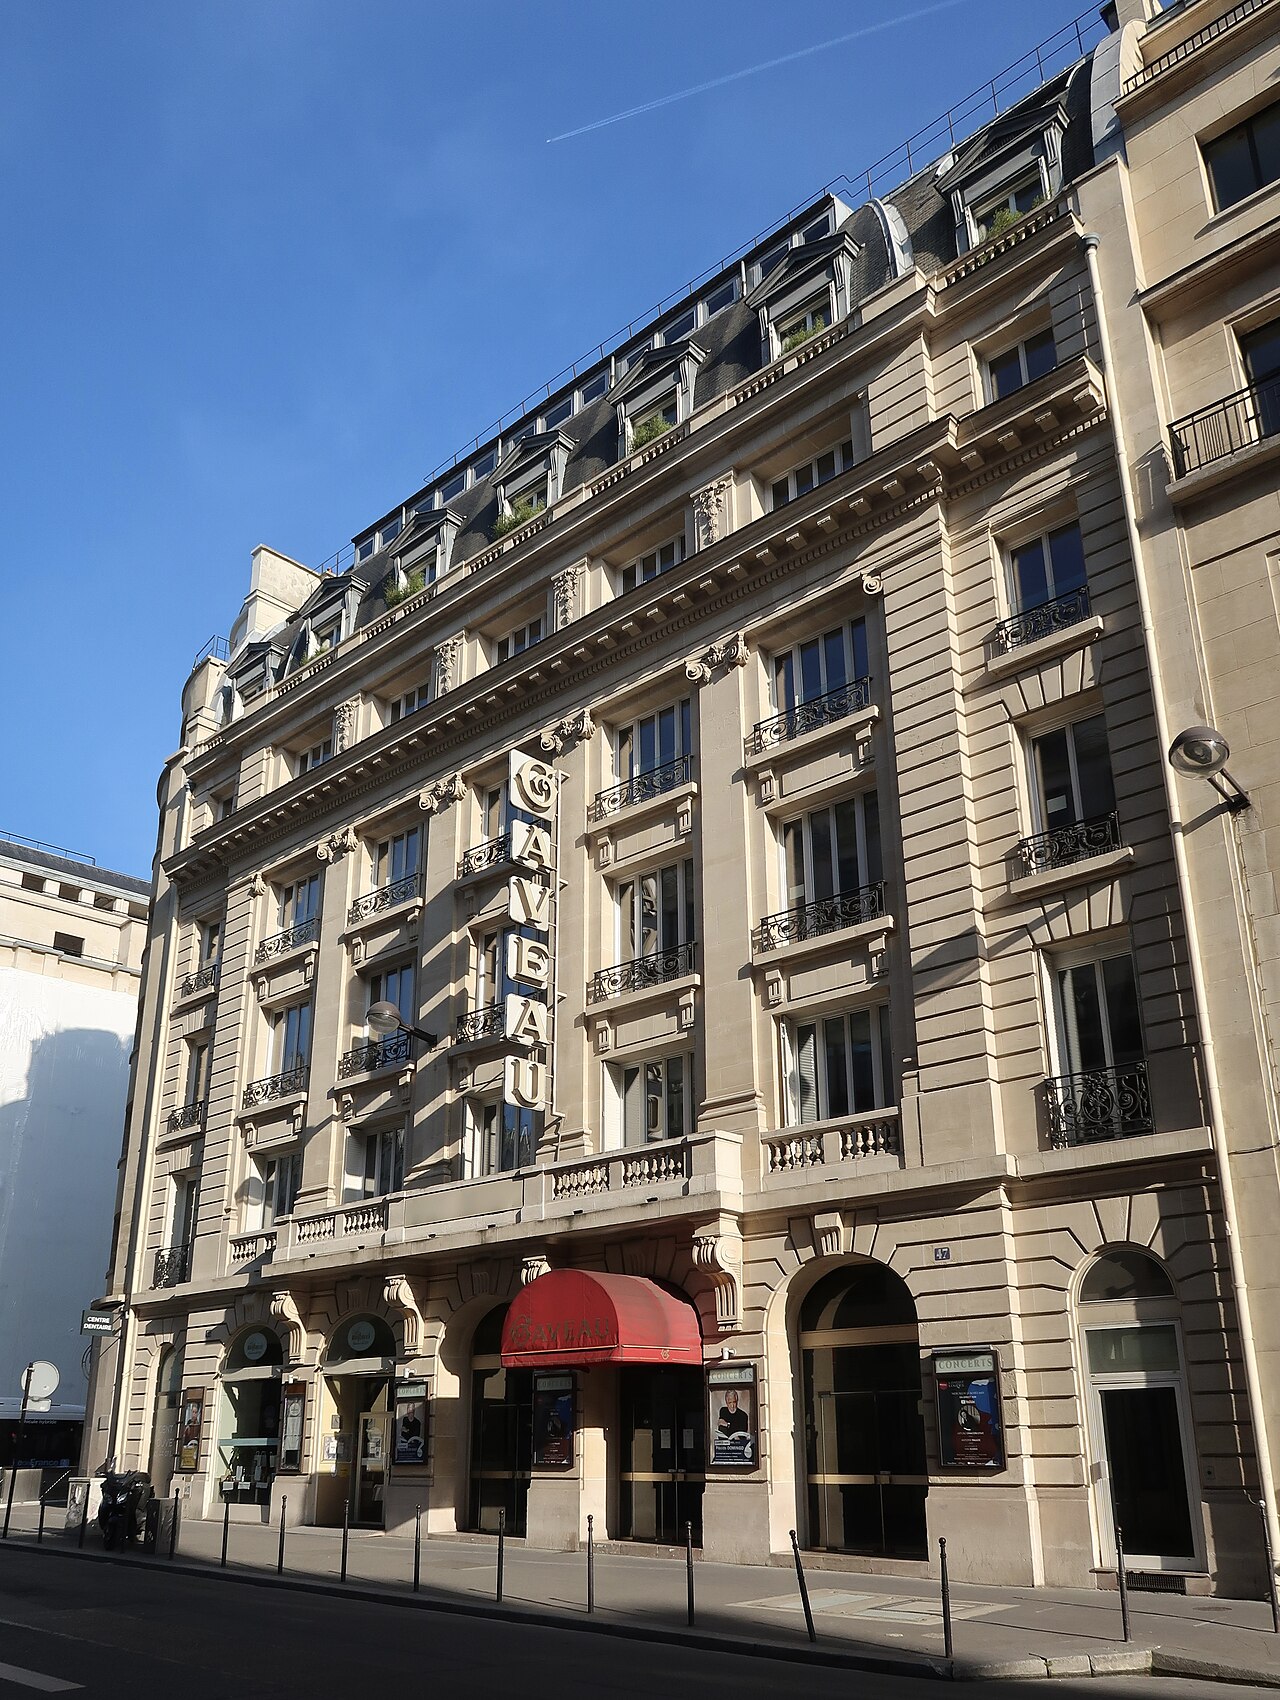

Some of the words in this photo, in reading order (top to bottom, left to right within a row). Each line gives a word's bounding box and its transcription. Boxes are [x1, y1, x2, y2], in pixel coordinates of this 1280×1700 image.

[508, 758, 557, 1108] GAVEAU
[936, 1248, 948, 1259] 47
[83, 1323, 112, 1331] DENTAIRE
[510, 1313, 610, 1346] GAVEAU
[939, 1358, 993, 1369] CONCERTS
[712, 1370, 753, 1380] CONCERTS
